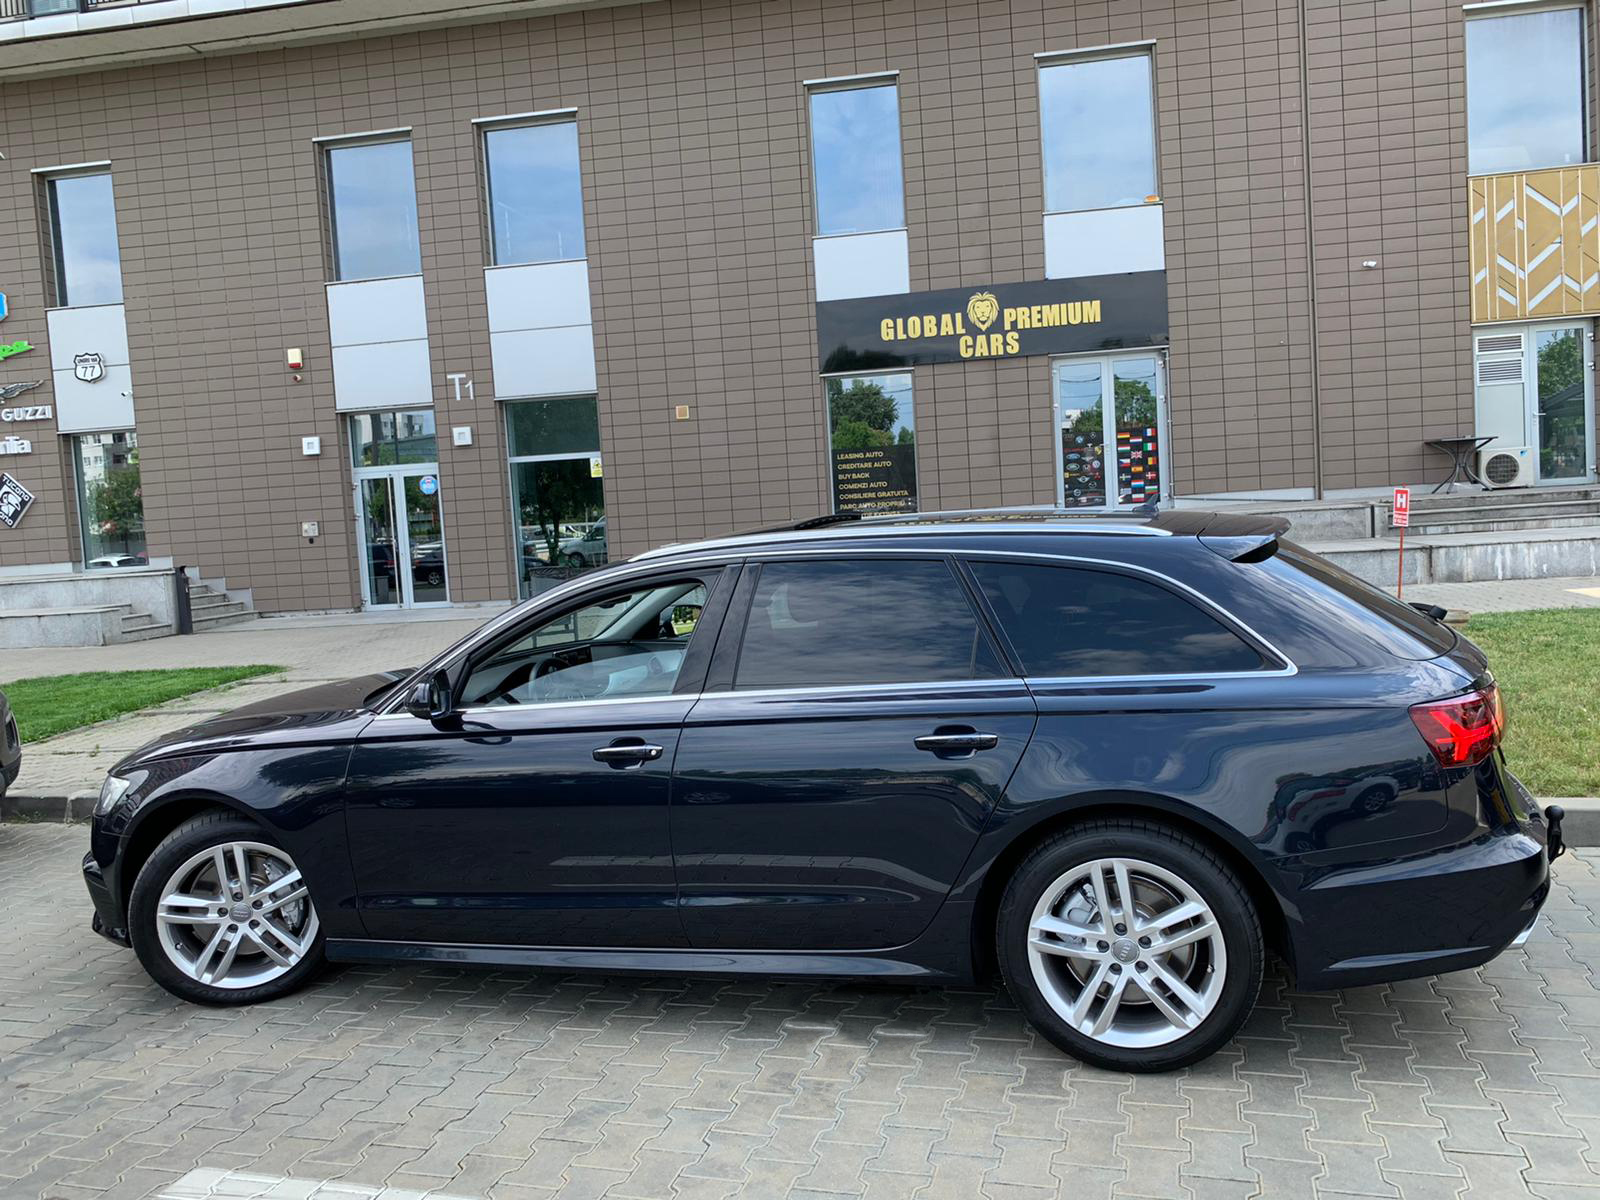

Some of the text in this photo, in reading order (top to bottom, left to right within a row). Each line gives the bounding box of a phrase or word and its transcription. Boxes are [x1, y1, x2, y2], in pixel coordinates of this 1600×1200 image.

[880, 300, 1101, 341] GLOBAL PREMIUM
[959, 331, 1020, 359] CARS
[81, 365, 95, 378] 77
[447, 373, 474, 401] T1
[1, 405, 52, 421] GUZZI
[837, 460, 892, 470] CREDITARE AUTO
[1397, 493, 1406, 508] H
